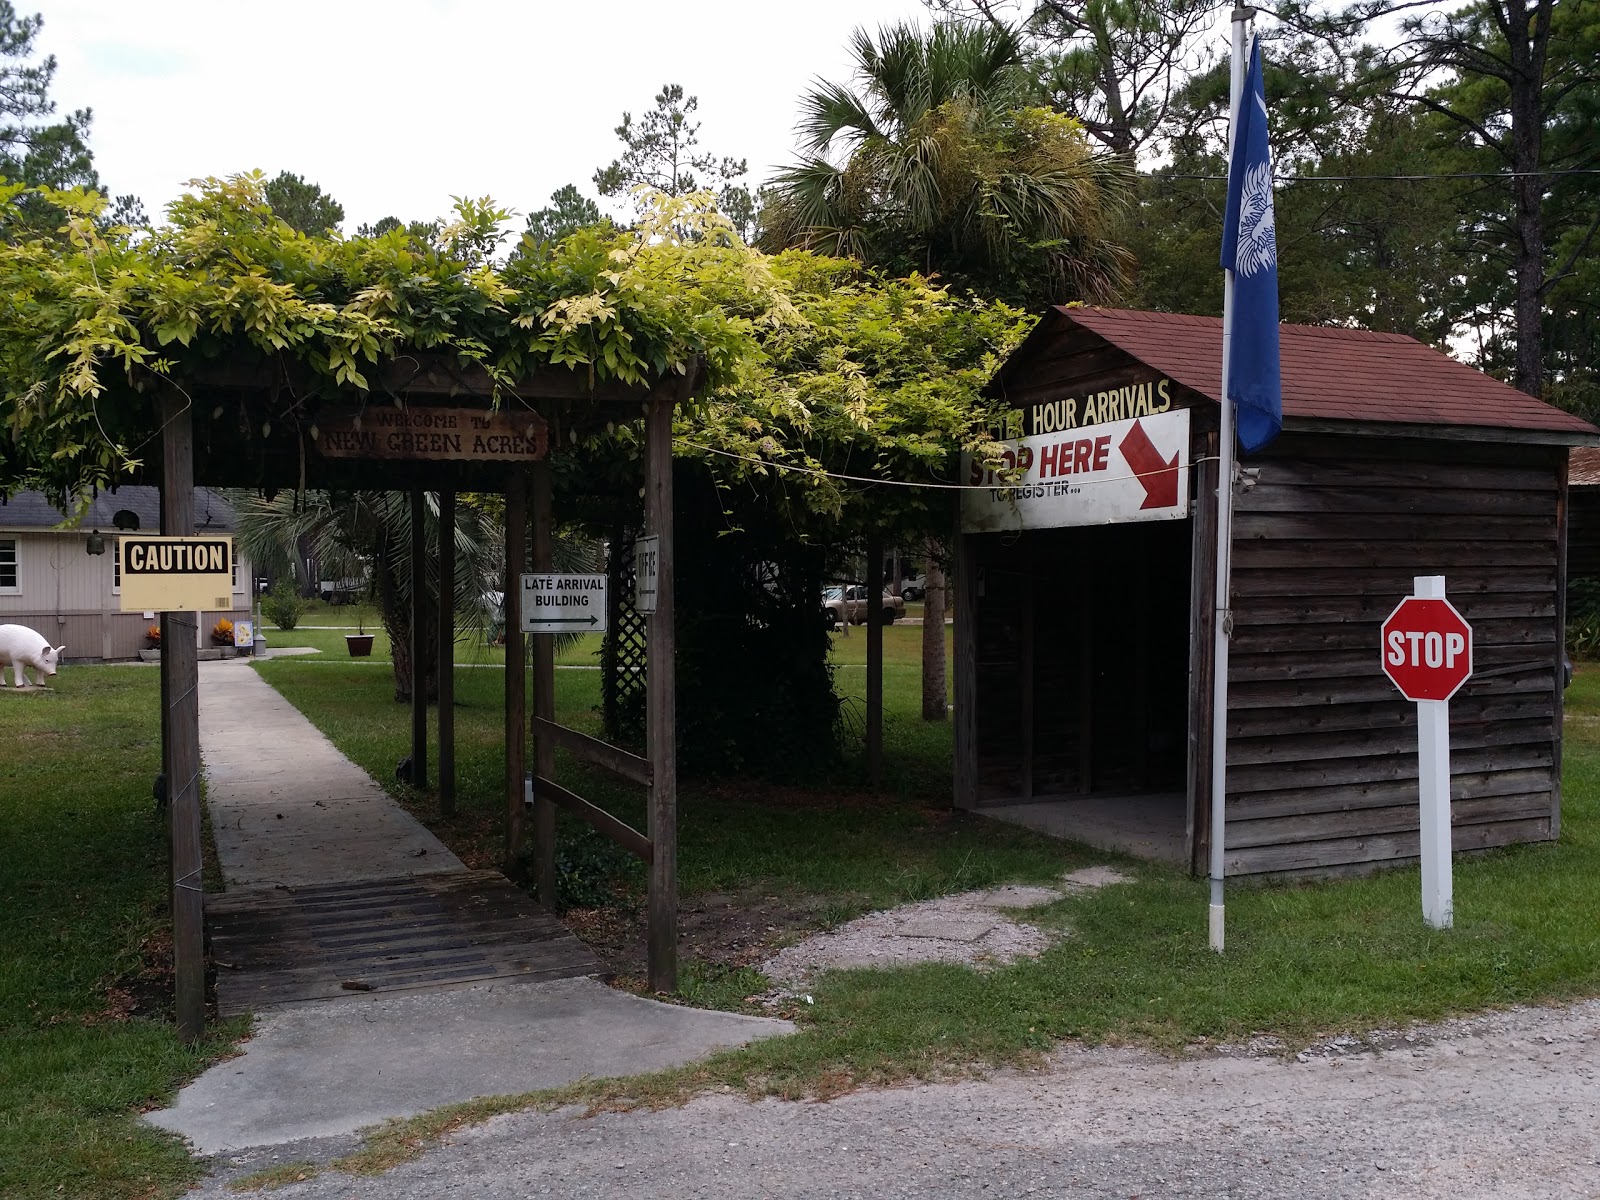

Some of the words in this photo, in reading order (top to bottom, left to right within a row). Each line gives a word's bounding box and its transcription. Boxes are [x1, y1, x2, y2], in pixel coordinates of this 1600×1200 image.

[1032, 398, 1077, 435] HOUR
[1082, 379, 1171, 426] ARRIVALS
[375, 412, 457, 429] WELCOME
[470, 415, 492, 430] TO
[323, 431, 377, 452] NEW
[386, 432, 462, 453] GREEN
[472, 435, 538, 455] ACRES
[1039, 435, 1112, 478] HERE
[990, 487, 1007, 502] TO
[130, 544, 223, 571] CAUTION
[525, 579, 553, 590] LATE
[556, 579, 604, 590] ARRIVAL
[535, 595, 589, 606] BUILDING
[1387, 630, 1465, 669] STOP
